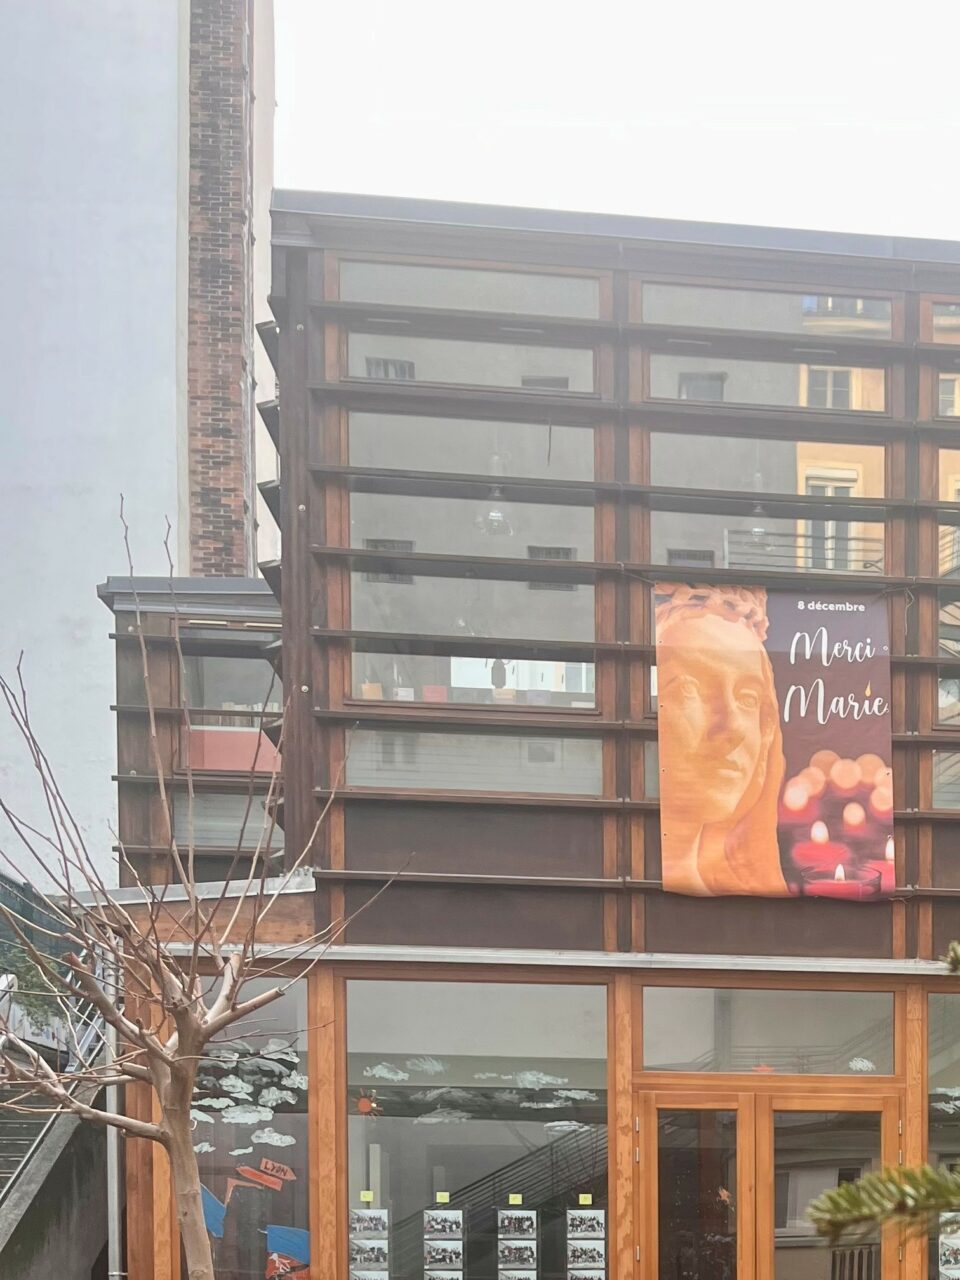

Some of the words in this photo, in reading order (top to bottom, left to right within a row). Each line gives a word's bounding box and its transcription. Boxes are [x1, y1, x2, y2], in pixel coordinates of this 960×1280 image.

[797, 600, 805, 610] 8
[807, 601, 866, 612] décembre
[790, 626, 876, 667] Merci
[784, 678, 889, 725] Marie
[263, 1160, 288, 1177] LYON
